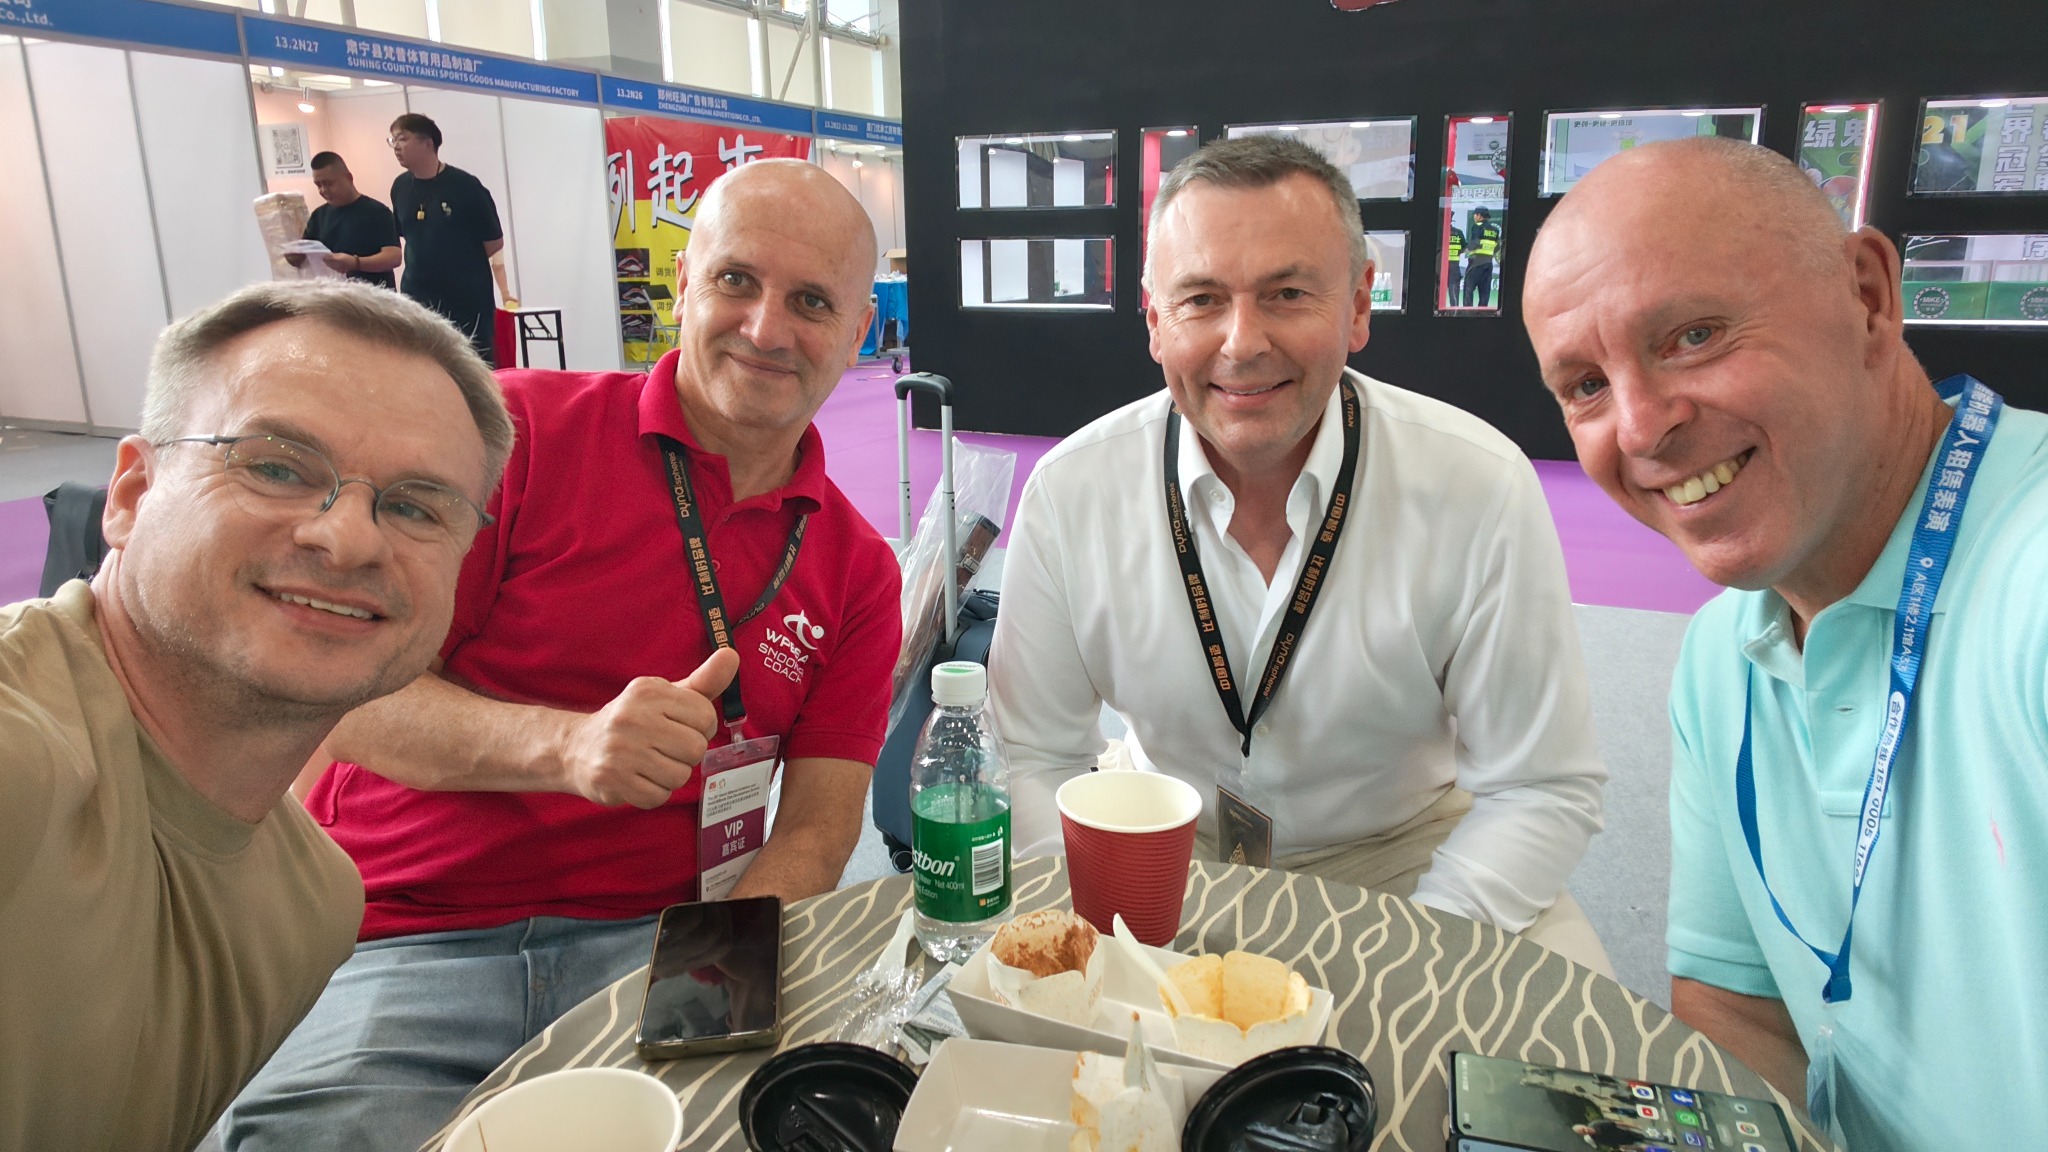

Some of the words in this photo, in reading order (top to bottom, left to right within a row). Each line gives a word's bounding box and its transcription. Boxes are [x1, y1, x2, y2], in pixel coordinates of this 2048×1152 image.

[275, 36, 319, 53] 13.2N27
[347, 57, 381, 70] SUNING
[382, 61, 416, 74] COUNTY
[416, 68, 438, 78] FANXI
[439, 71, 468, 83] SPORTS
[469, 74, 494, 86] GOODS
[494, 78, 551, 93] MANUFACTURING
[551, 86, 579, 97] FACTORY
[616, 88, 643, 100] 13.2N26
[1345, 402, 1355, 428] TITAN
[1319, 492, 1346, 544] 中国智造
[689, 537, 716, 596] 比利时品牌
[1291, 554, 1326, 616] 比利时品牌
[1187, 573, 1215, 633] 比利时品牌
[1208, 643, 1231, 691] 中国智造
[721, 836, 746, 857] 嘉宾证
[724, 819, 744, 838] VIP
